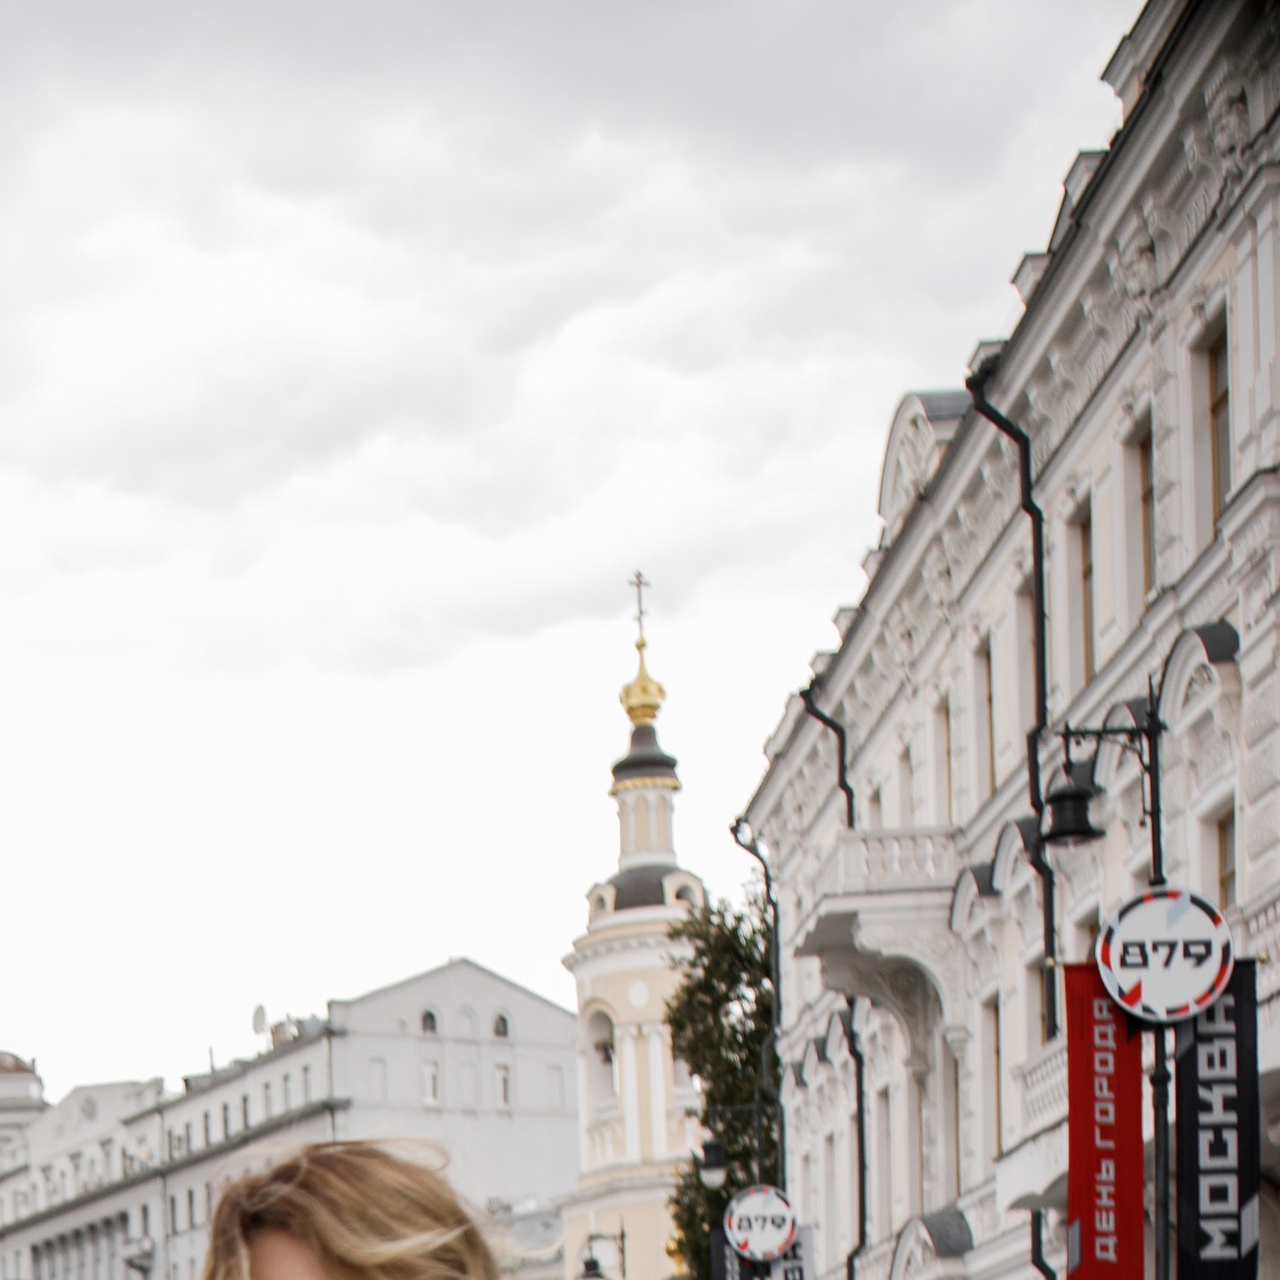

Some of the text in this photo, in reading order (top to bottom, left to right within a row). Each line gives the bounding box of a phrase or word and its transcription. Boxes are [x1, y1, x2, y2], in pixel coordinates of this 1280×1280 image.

[1120, 940, 1212, 969] 879
[1093, 997, 1117, 1263] ДЕНЬ ГОРОДА
[1197, 992, 1239, 1261] МОСКВА
